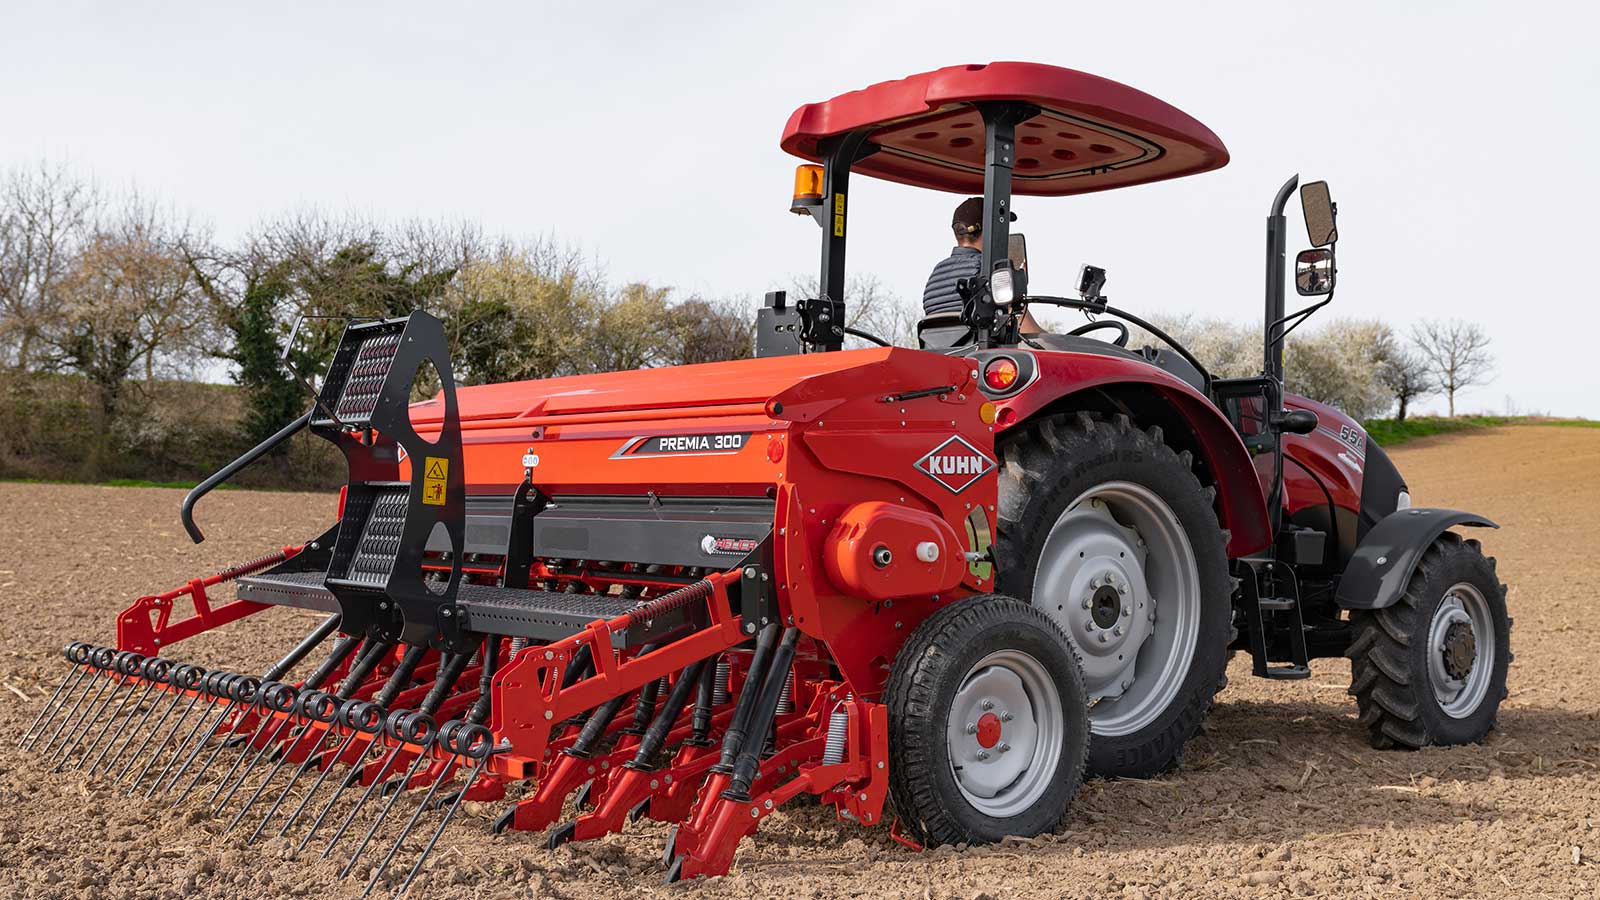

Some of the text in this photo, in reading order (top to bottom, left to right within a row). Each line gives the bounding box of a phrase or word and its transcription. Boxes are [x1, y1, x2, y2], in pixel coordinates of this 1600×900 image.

[659, 434, 742, 451] PREMIA 300
[929, 455, 983, 475] KUHN
